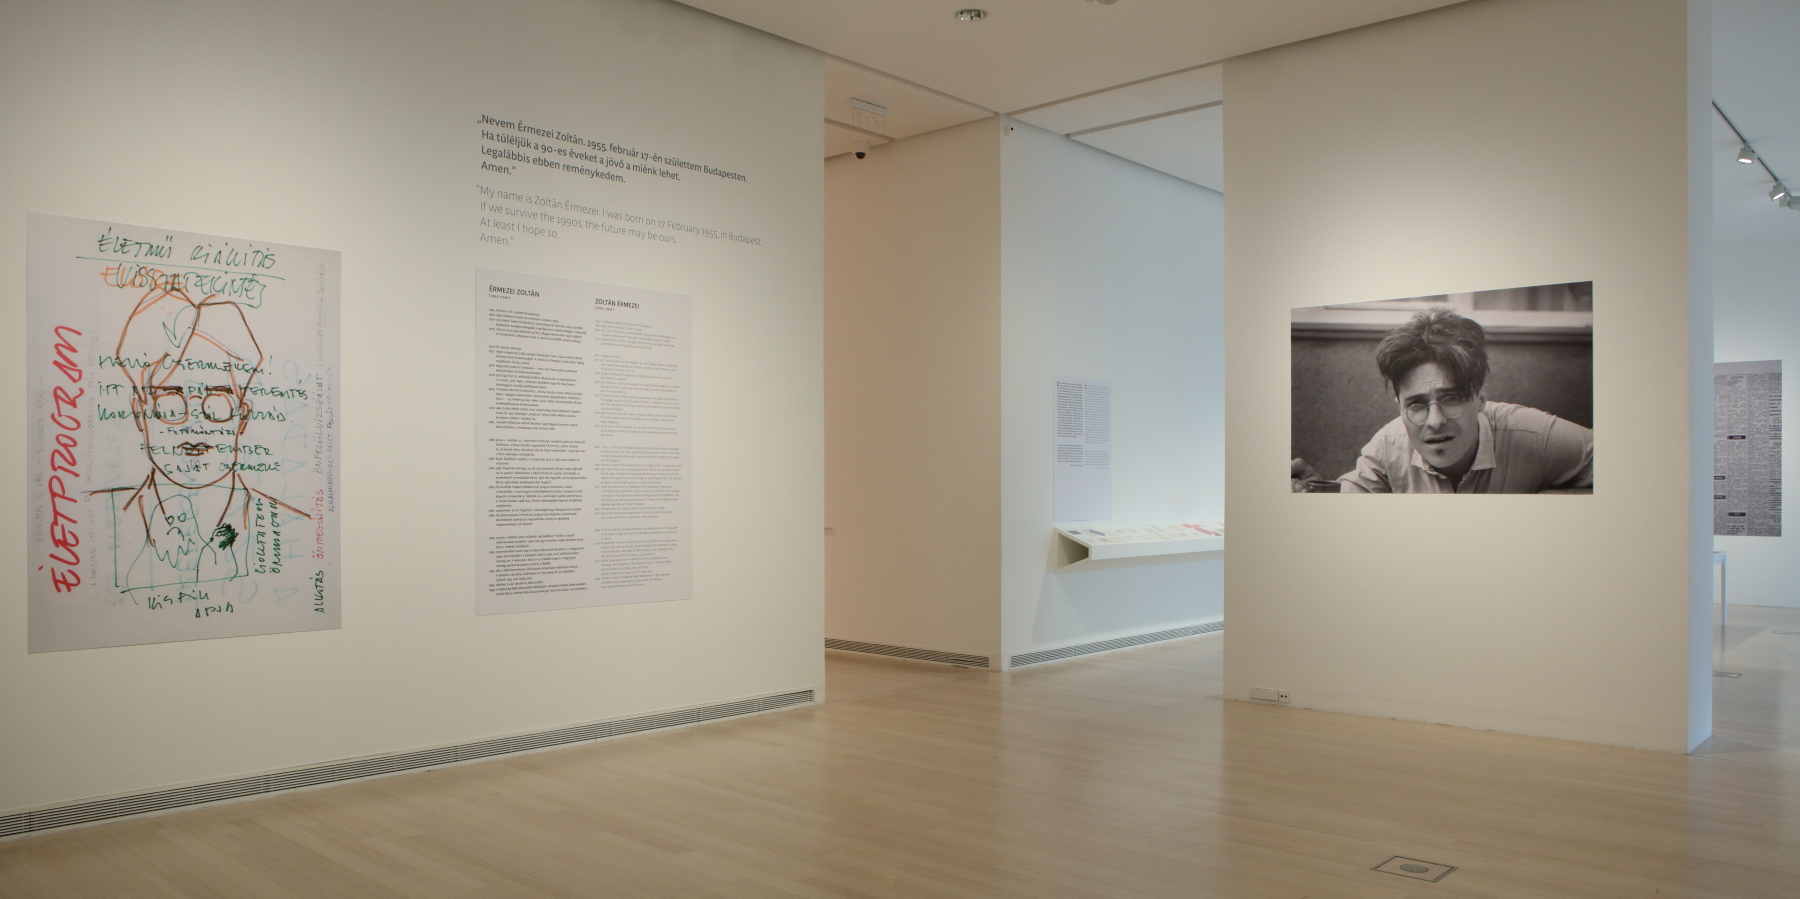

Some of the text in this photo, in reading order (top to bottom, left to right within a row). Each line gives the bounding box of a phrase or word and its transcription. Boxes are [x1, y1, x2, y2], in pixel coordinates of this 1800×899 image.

[477, 114, 748, 182] „Nevem Érmezei Zoltán. 1955. február 17-én születtem Budapesten.
[481, 146, 626, 184] Legalábbis ebben reménykedem.
[482, 130, 494, 140] Ha
[496, 132, 532, 149] túléljük
[534, 142, 539, 150] a
[541, 144, 566, 158] 90-es
[569, 148, 598, 164] éveket
[606, 156, 624, 170] jövő
[626, 162, 631, 170] a
[633, 163, 658, 176] miénk
[659, 168, 680, 181] lehet.
[480, 202, 677, 244] If we survive the 1990s, the future may be ours.
[480, 217, 560, 238] At least I hope so.
[489, 284, 540, 298] ÉRMEZEI ZOLTÁN
[595, 298, 640, 309] ZOLTÁN ÉRMEZEI
